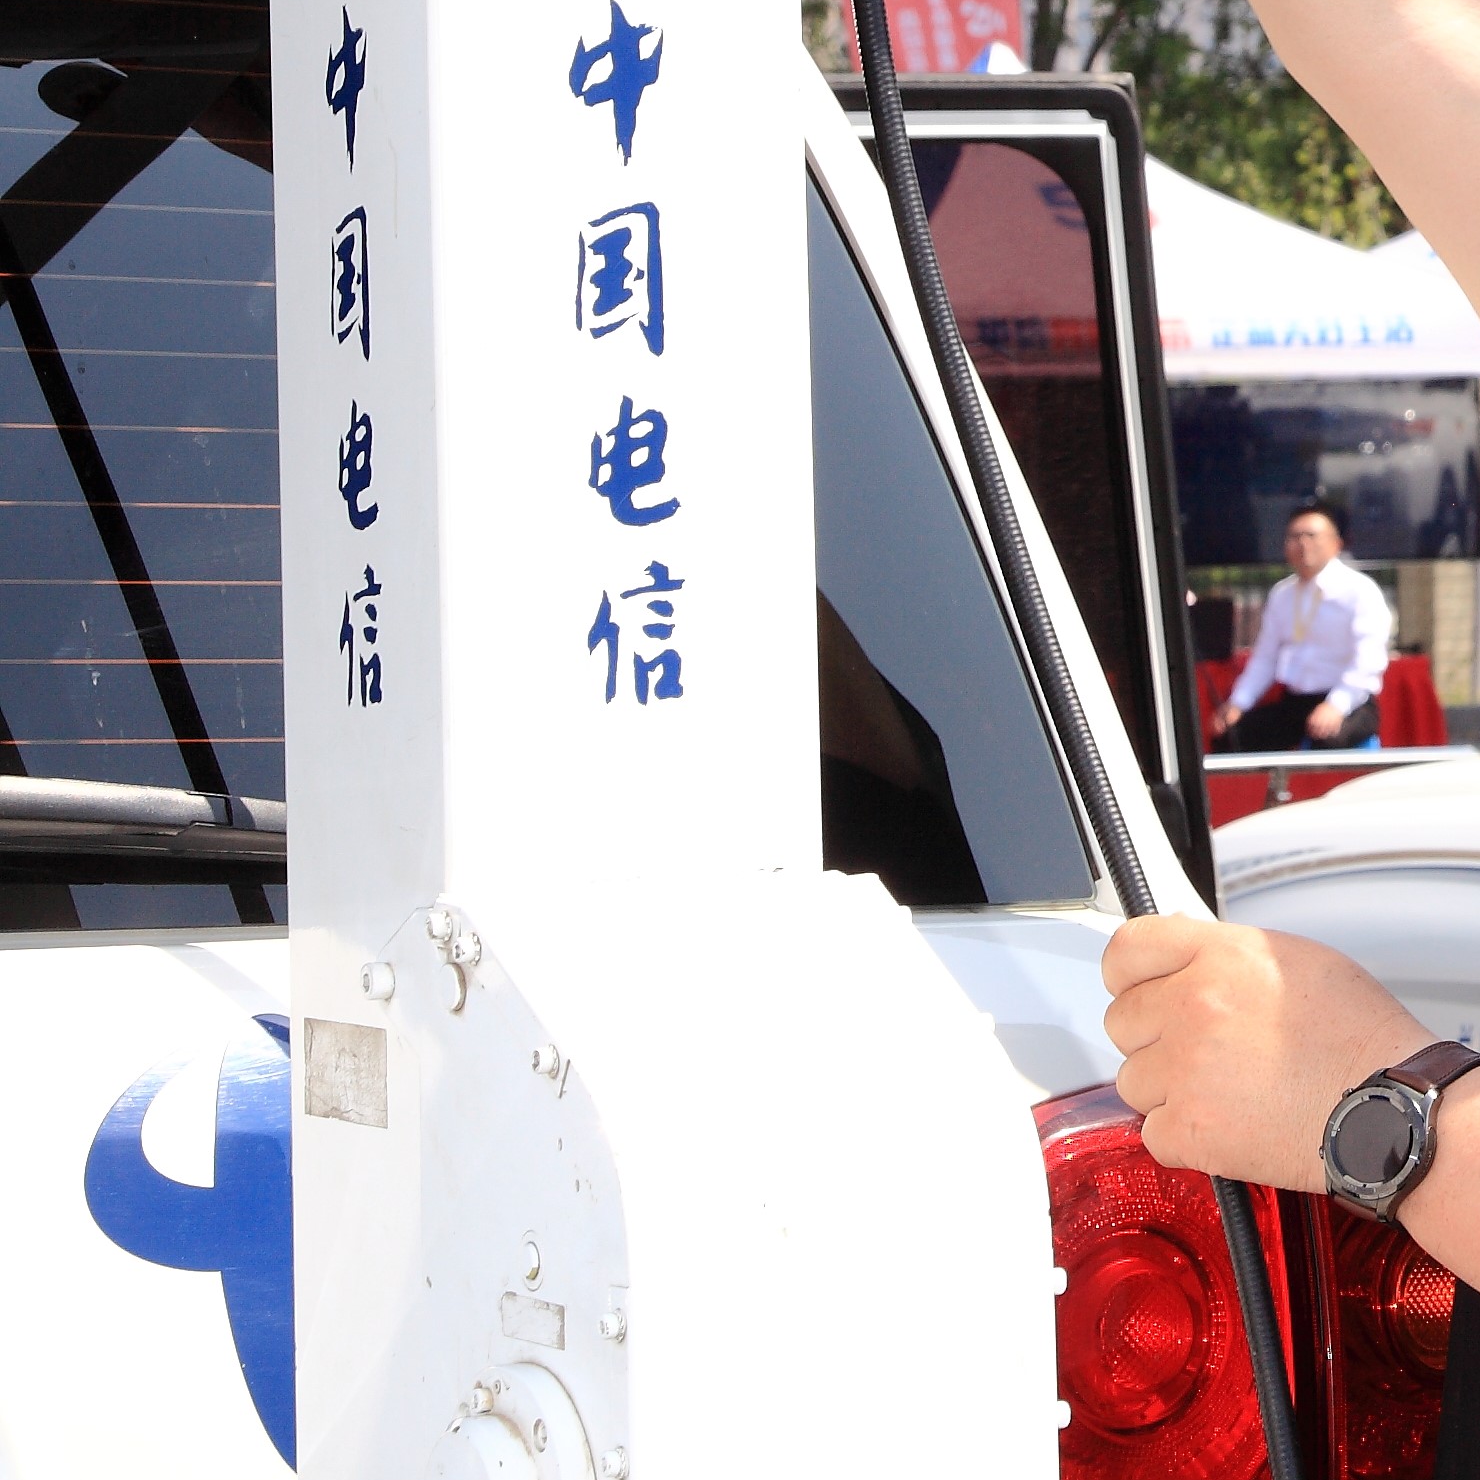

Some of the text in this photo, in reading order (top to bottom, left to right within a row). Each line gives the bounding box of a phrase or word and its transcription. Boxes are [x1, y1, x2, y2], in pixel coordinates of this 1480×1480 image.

[326, 5, 382, 706] 中国电信
[569, 0, 685, 705] 中国电信
